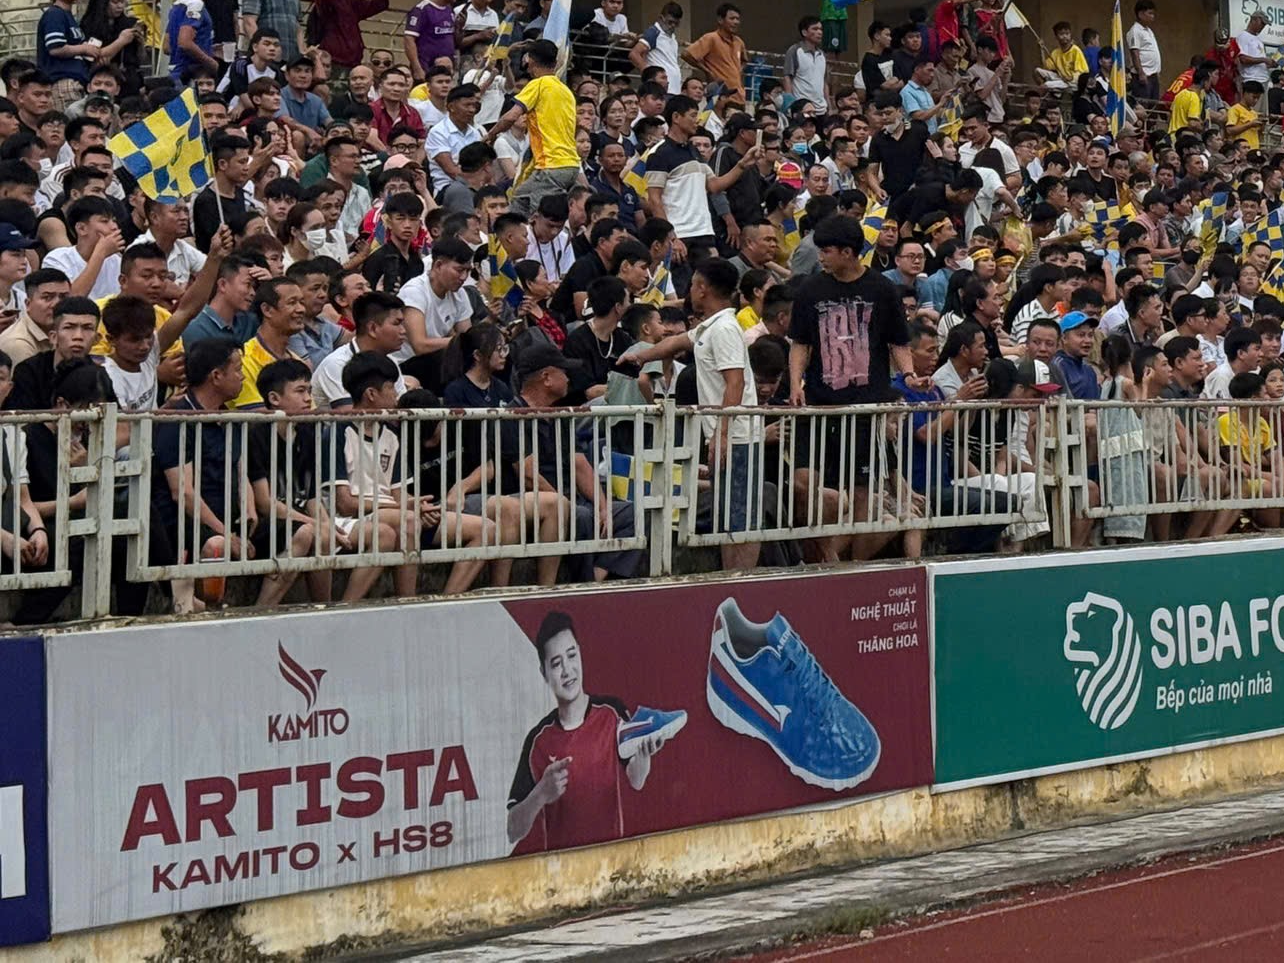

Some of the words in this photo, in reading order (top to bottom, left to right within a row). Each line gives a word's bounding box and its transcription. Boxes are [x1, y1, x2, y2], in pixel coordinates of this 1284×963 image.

[851, 601, 881, 621] NGHỆ
[883, 597, 917, 617] THUẬT
[857, 635, 894, 653] THĂNG
[895, 633, 919, 649] HOA
[1149, 601, 1243, 670] SIBA
[1155, 679, 1185, 714] Bếp
[1187, 678, 1214, 705] của
[1217, 680, 1244, 706] mọi
[1246, 670, 1273, 697] nhà
[268, 708, 350, 743] KAMITO
[120, 744, 479, 852] ARTISTA
[152, 841, 320, 894] KAMITO
[337, 842, 357, 864] x
[373, 820, 454, 858] HS8
